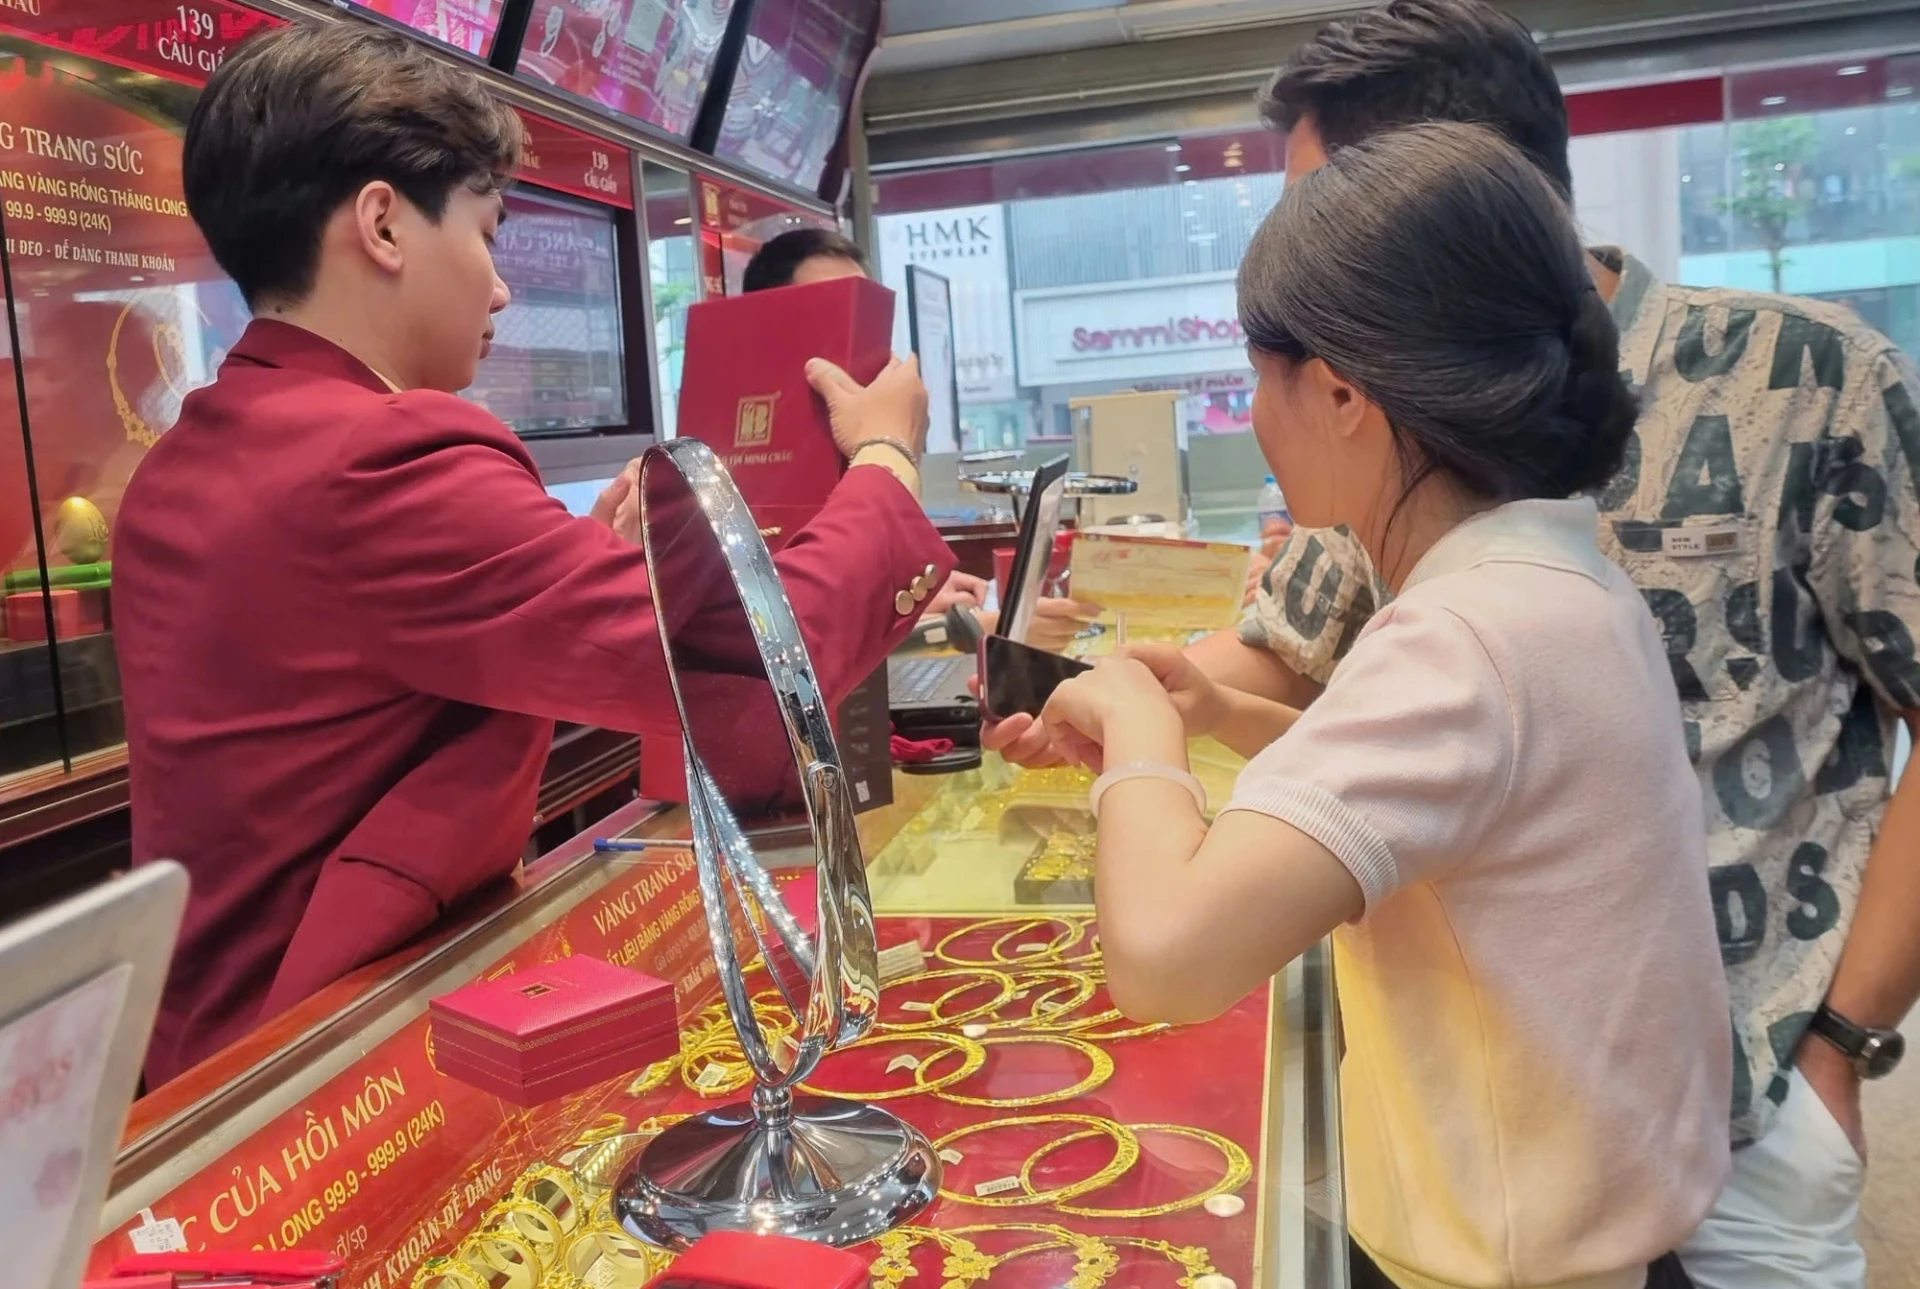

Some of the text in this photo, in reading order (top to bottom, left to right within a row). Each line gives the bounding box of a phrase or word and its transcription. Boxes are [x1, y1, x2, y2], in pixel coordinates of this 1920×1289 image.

[176, 5, 214, 40] 139
[158, 31, 194, 67] CẦU
[20, 126, 98, 167] TRANG
[103, 141, 144, 175] SỨC
[591, 151, 609, 171] 139
[27, 172, 68, 197] VÀNG
[108, 188, 153, 212] THĂNG
[154, 198, 188, 217] LONG
[5, 200, 34, 220] 99.9
[44, 206, 78, 227] 999.9
[80, 210, 112, 235] (24K)
[905, 215, 992, 246] HMK
[19, 239, 43, 257] ĐEO
[55, 238, 70, 259] DỄ
[73, 245, 102, 263] DÀNG
[105, 250, 139, 268] THANH
[592, 890, 636, 936] VÀNG
[632, 860, 678, 907] TRANG
[208, 1165, 282, 1234] CỦA
[282, 1110, 339, 1181] HỒI
[340, 1067, 406, 1138] MÔN
[268, 1198, 326, 1252] LONG
[323, 1169, 361, 1212] 99.9
[366, 1129, 409, 1177] 999.9
[407, 1098, 446, 1149] (24K)
[385, 1215, 442, 1285] KHOẢN
[464, 1157, 503, 1209] DÀNG
